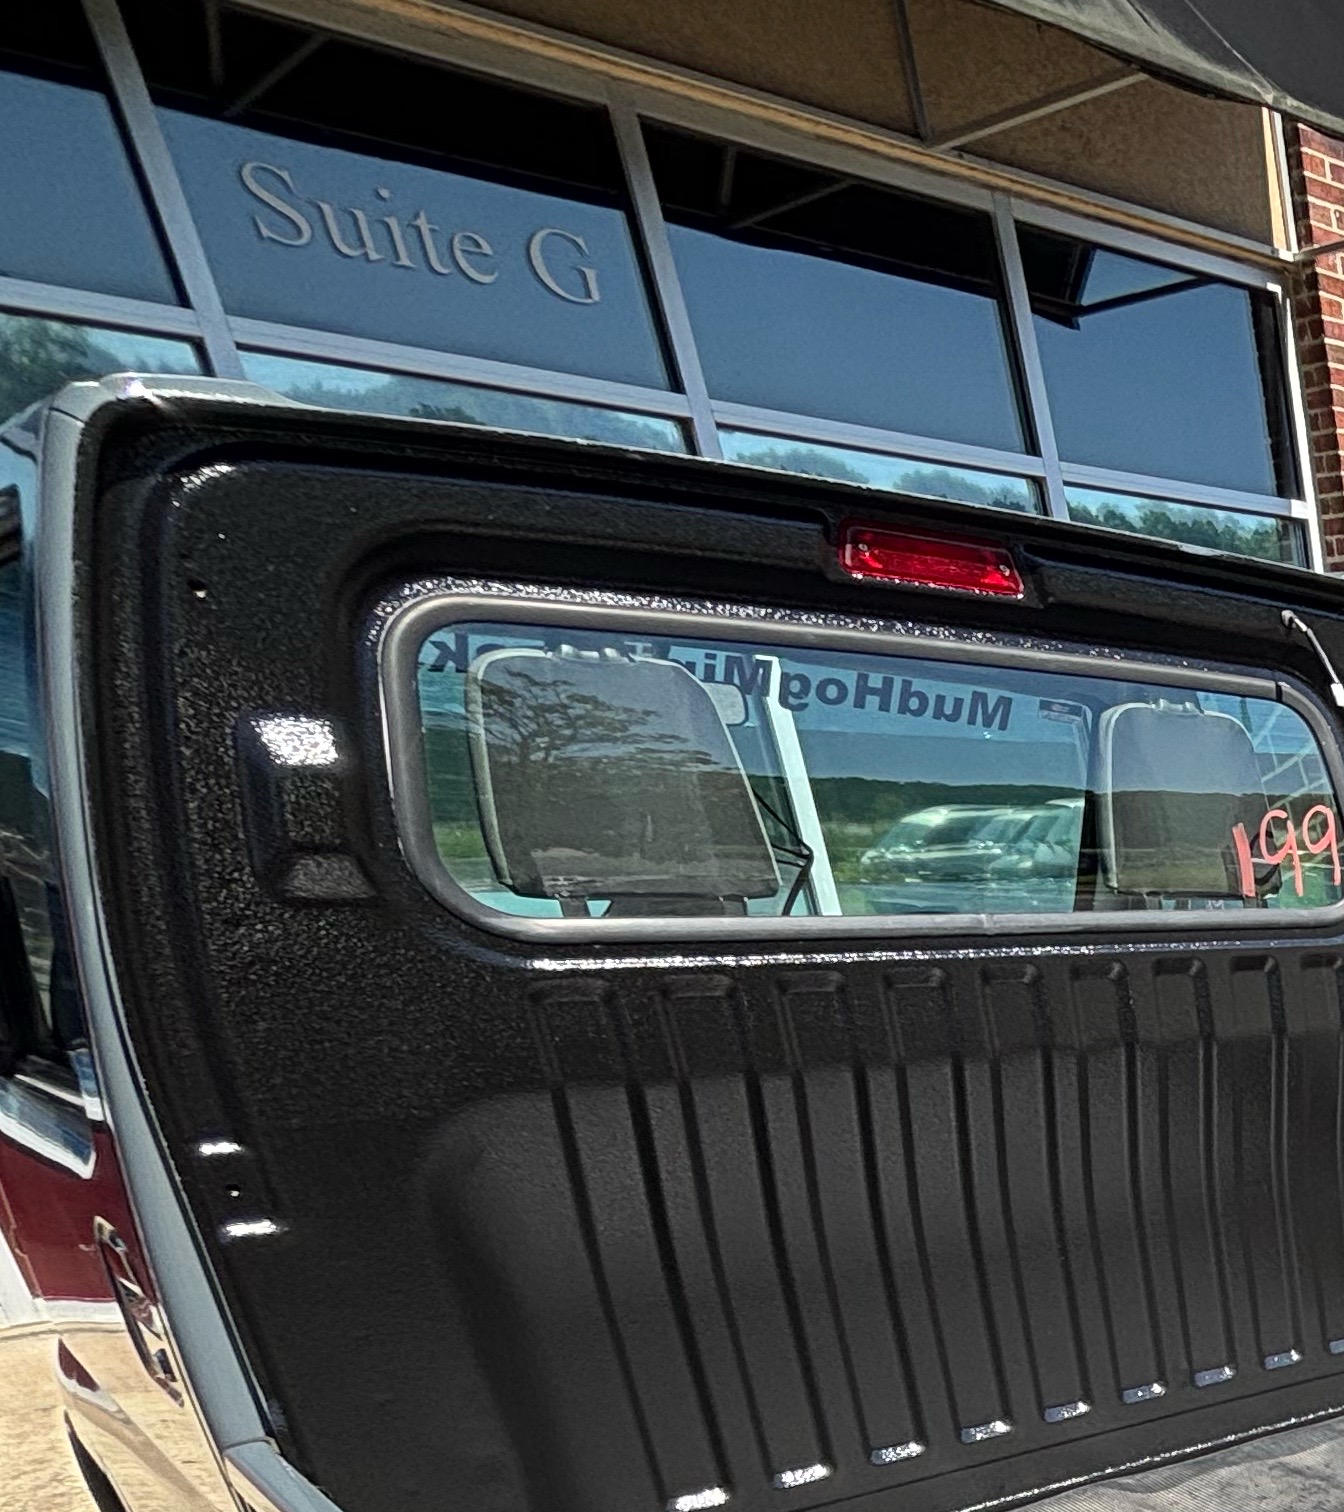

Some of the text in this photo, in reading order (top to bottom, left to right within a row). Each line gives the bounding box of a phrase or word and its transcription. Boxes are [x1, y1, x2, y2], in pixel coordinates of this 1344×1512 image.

[240, 160, 601, 305] Suite G
[1231, 804, 1342, 897] 199
